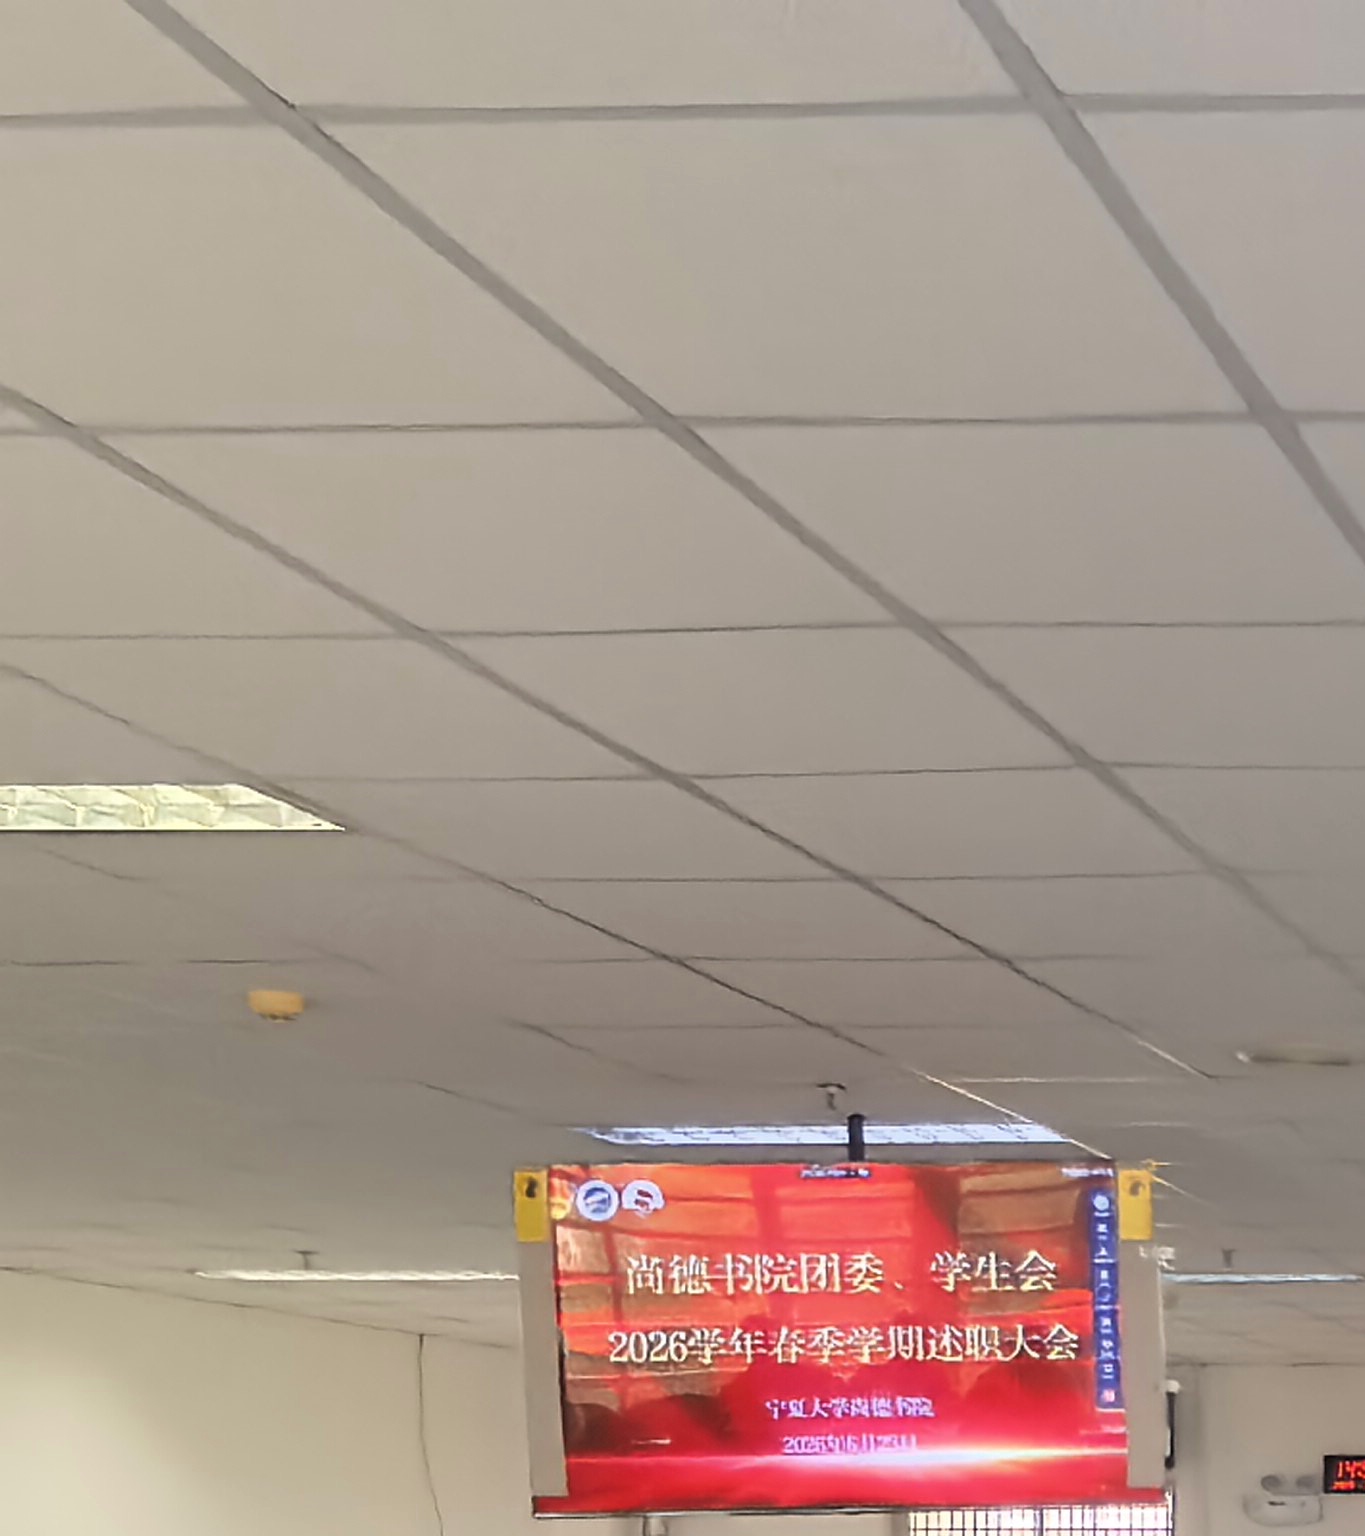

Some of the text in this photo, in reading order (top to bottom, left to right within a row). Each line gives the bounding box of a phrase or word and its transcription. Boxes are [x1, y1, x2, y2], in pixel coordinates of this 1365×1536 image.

[626, 1250, 1058, 1295] 尚德书院团委、学生会
[608, 1323, 1079, 1365] 2026学年春季学期述职大会
